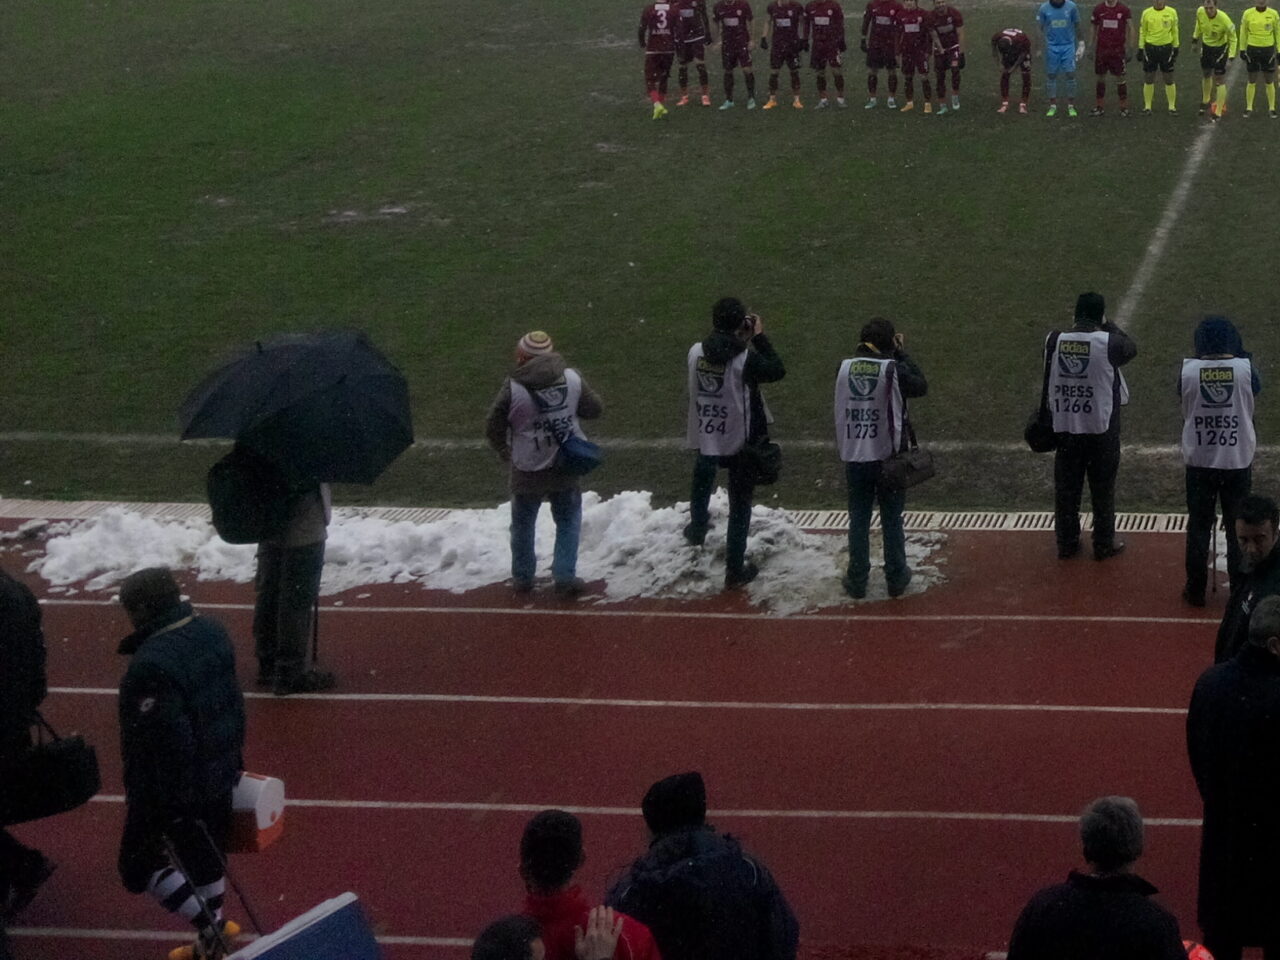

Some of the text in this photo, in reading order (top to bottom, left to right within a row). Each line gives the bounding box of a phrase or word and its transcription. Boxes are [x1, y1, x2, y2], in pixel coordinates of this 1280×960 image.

[657, 10, 668, 29] 3
[1201, 369, 1232, 381] iddaa
[1054, 384, 1094, 398] PRESS
[1055, 398, 1092, 413] 1266
[845, 408, 880, 421] PRESS
[1195, 415, 1239, 429] PRESS
[1196, 430, 1237, 446] 1265
